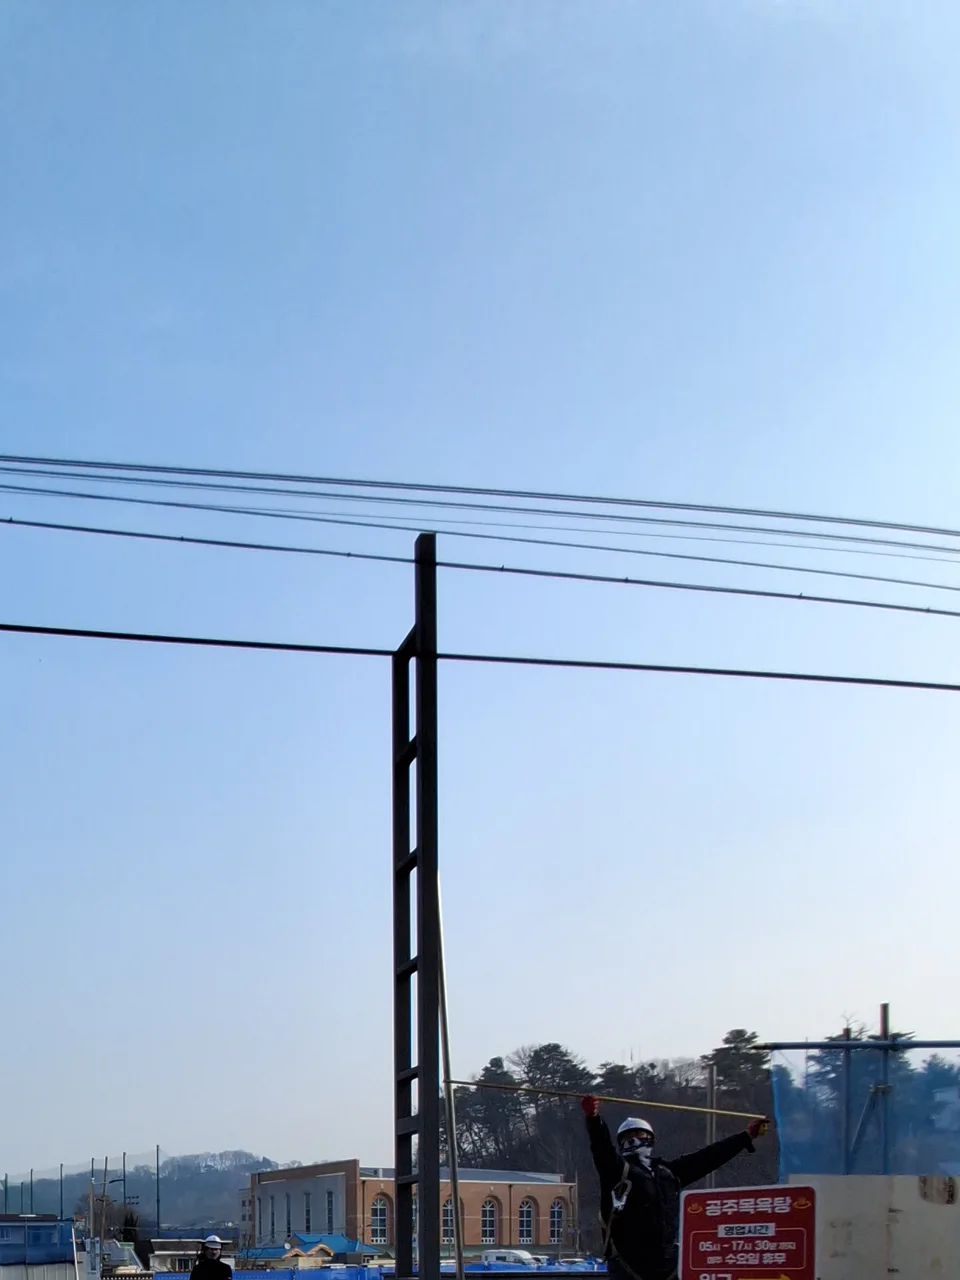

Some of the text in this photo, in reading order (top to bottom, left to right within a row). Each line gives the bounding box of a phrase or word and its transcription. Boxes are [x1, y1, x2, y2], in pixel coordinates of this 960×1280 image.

[705, 1196, 792, 1217] 공주목욕탕
[723, 1224, 769, 1236] 영업시간
[699, 1241, 721, 1251] 05시
[731, 1240, 752, 1251] 17시
[724, 1252, 760, 1265] 수요일
[762, 1252, 787, 1265] 휴무
